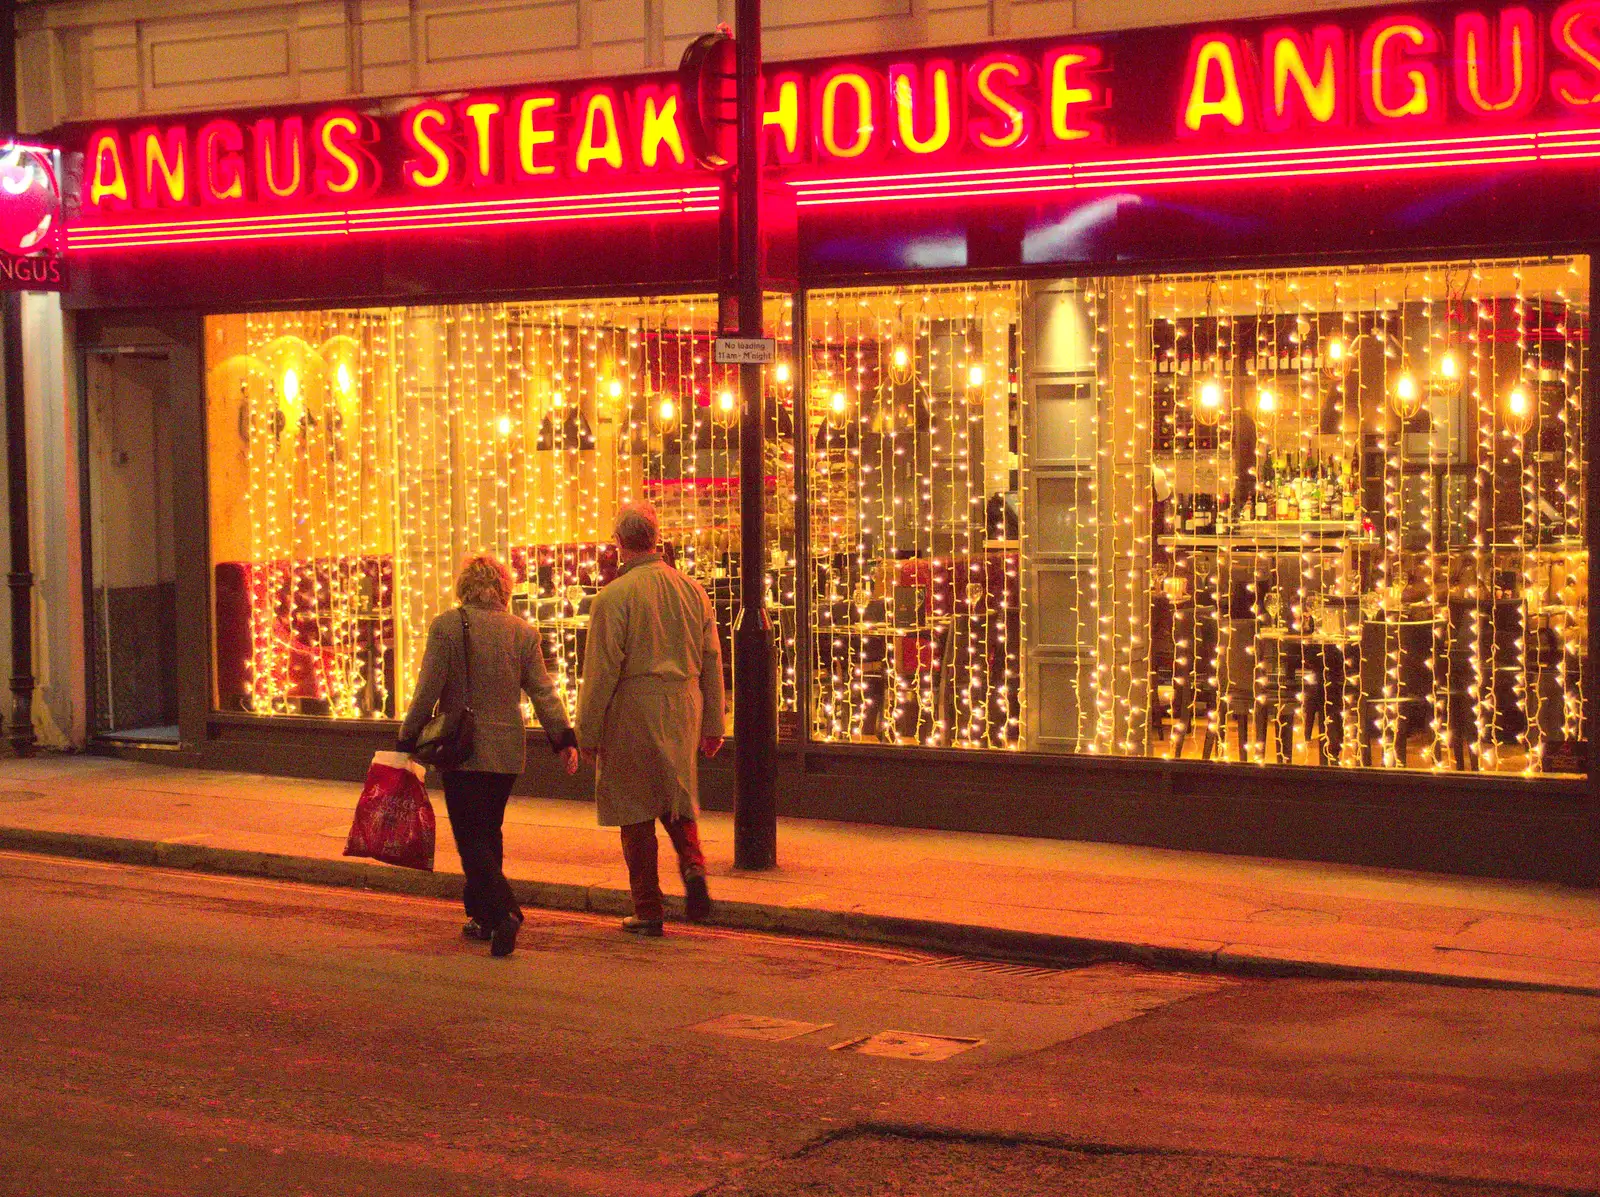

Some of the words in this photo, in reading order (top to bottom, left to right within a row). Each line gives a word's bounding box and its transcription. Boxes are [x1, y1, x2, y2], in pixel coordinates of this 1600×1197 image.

[84, 108, 364, 209] ANGUS
[402, 84, 692, 191] STEAK
[1178, 3, 1600, 134] ANGUS
[0, 256, 60, 283] NGUS
[738, 342, 765, 350] loading
